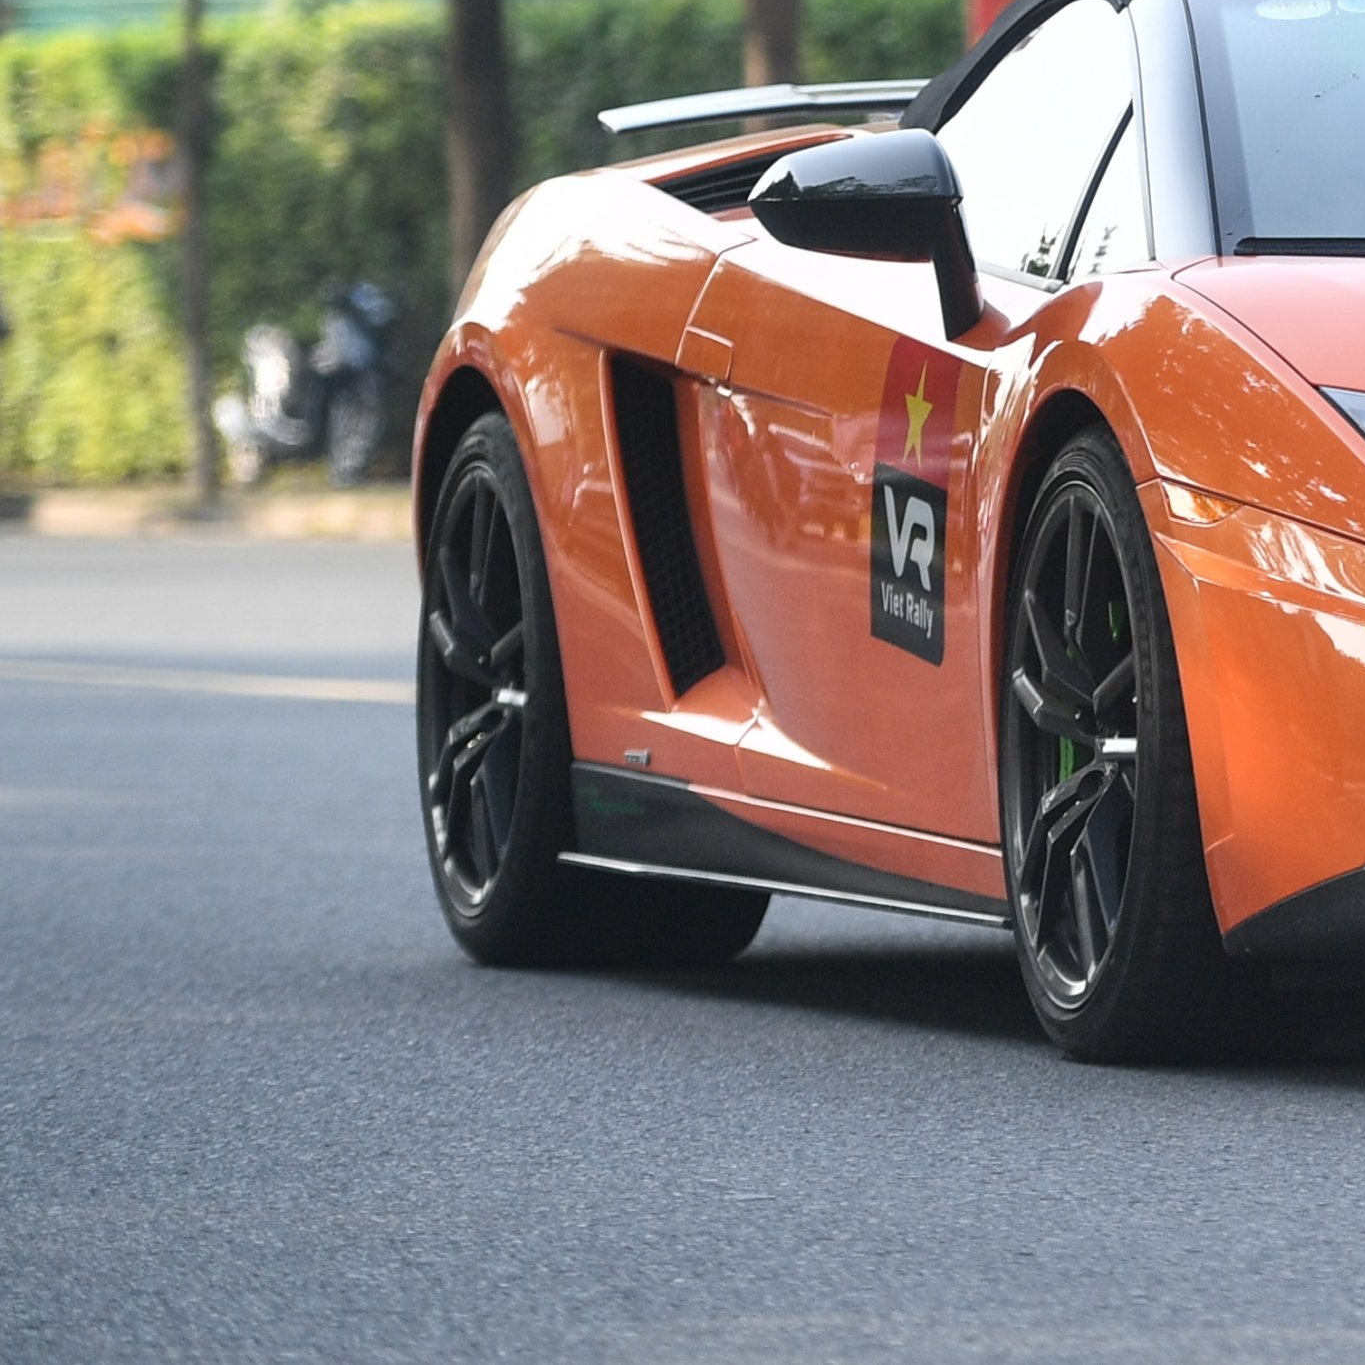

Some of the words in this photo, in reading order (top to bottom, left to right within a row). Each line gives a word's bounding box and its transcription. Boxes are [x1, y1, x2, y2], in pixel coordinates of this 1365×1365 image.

[883, 485, 935, 592] VR
[881, 581, 904, 618] Viet
[906, 592, 934, 640] Rally
